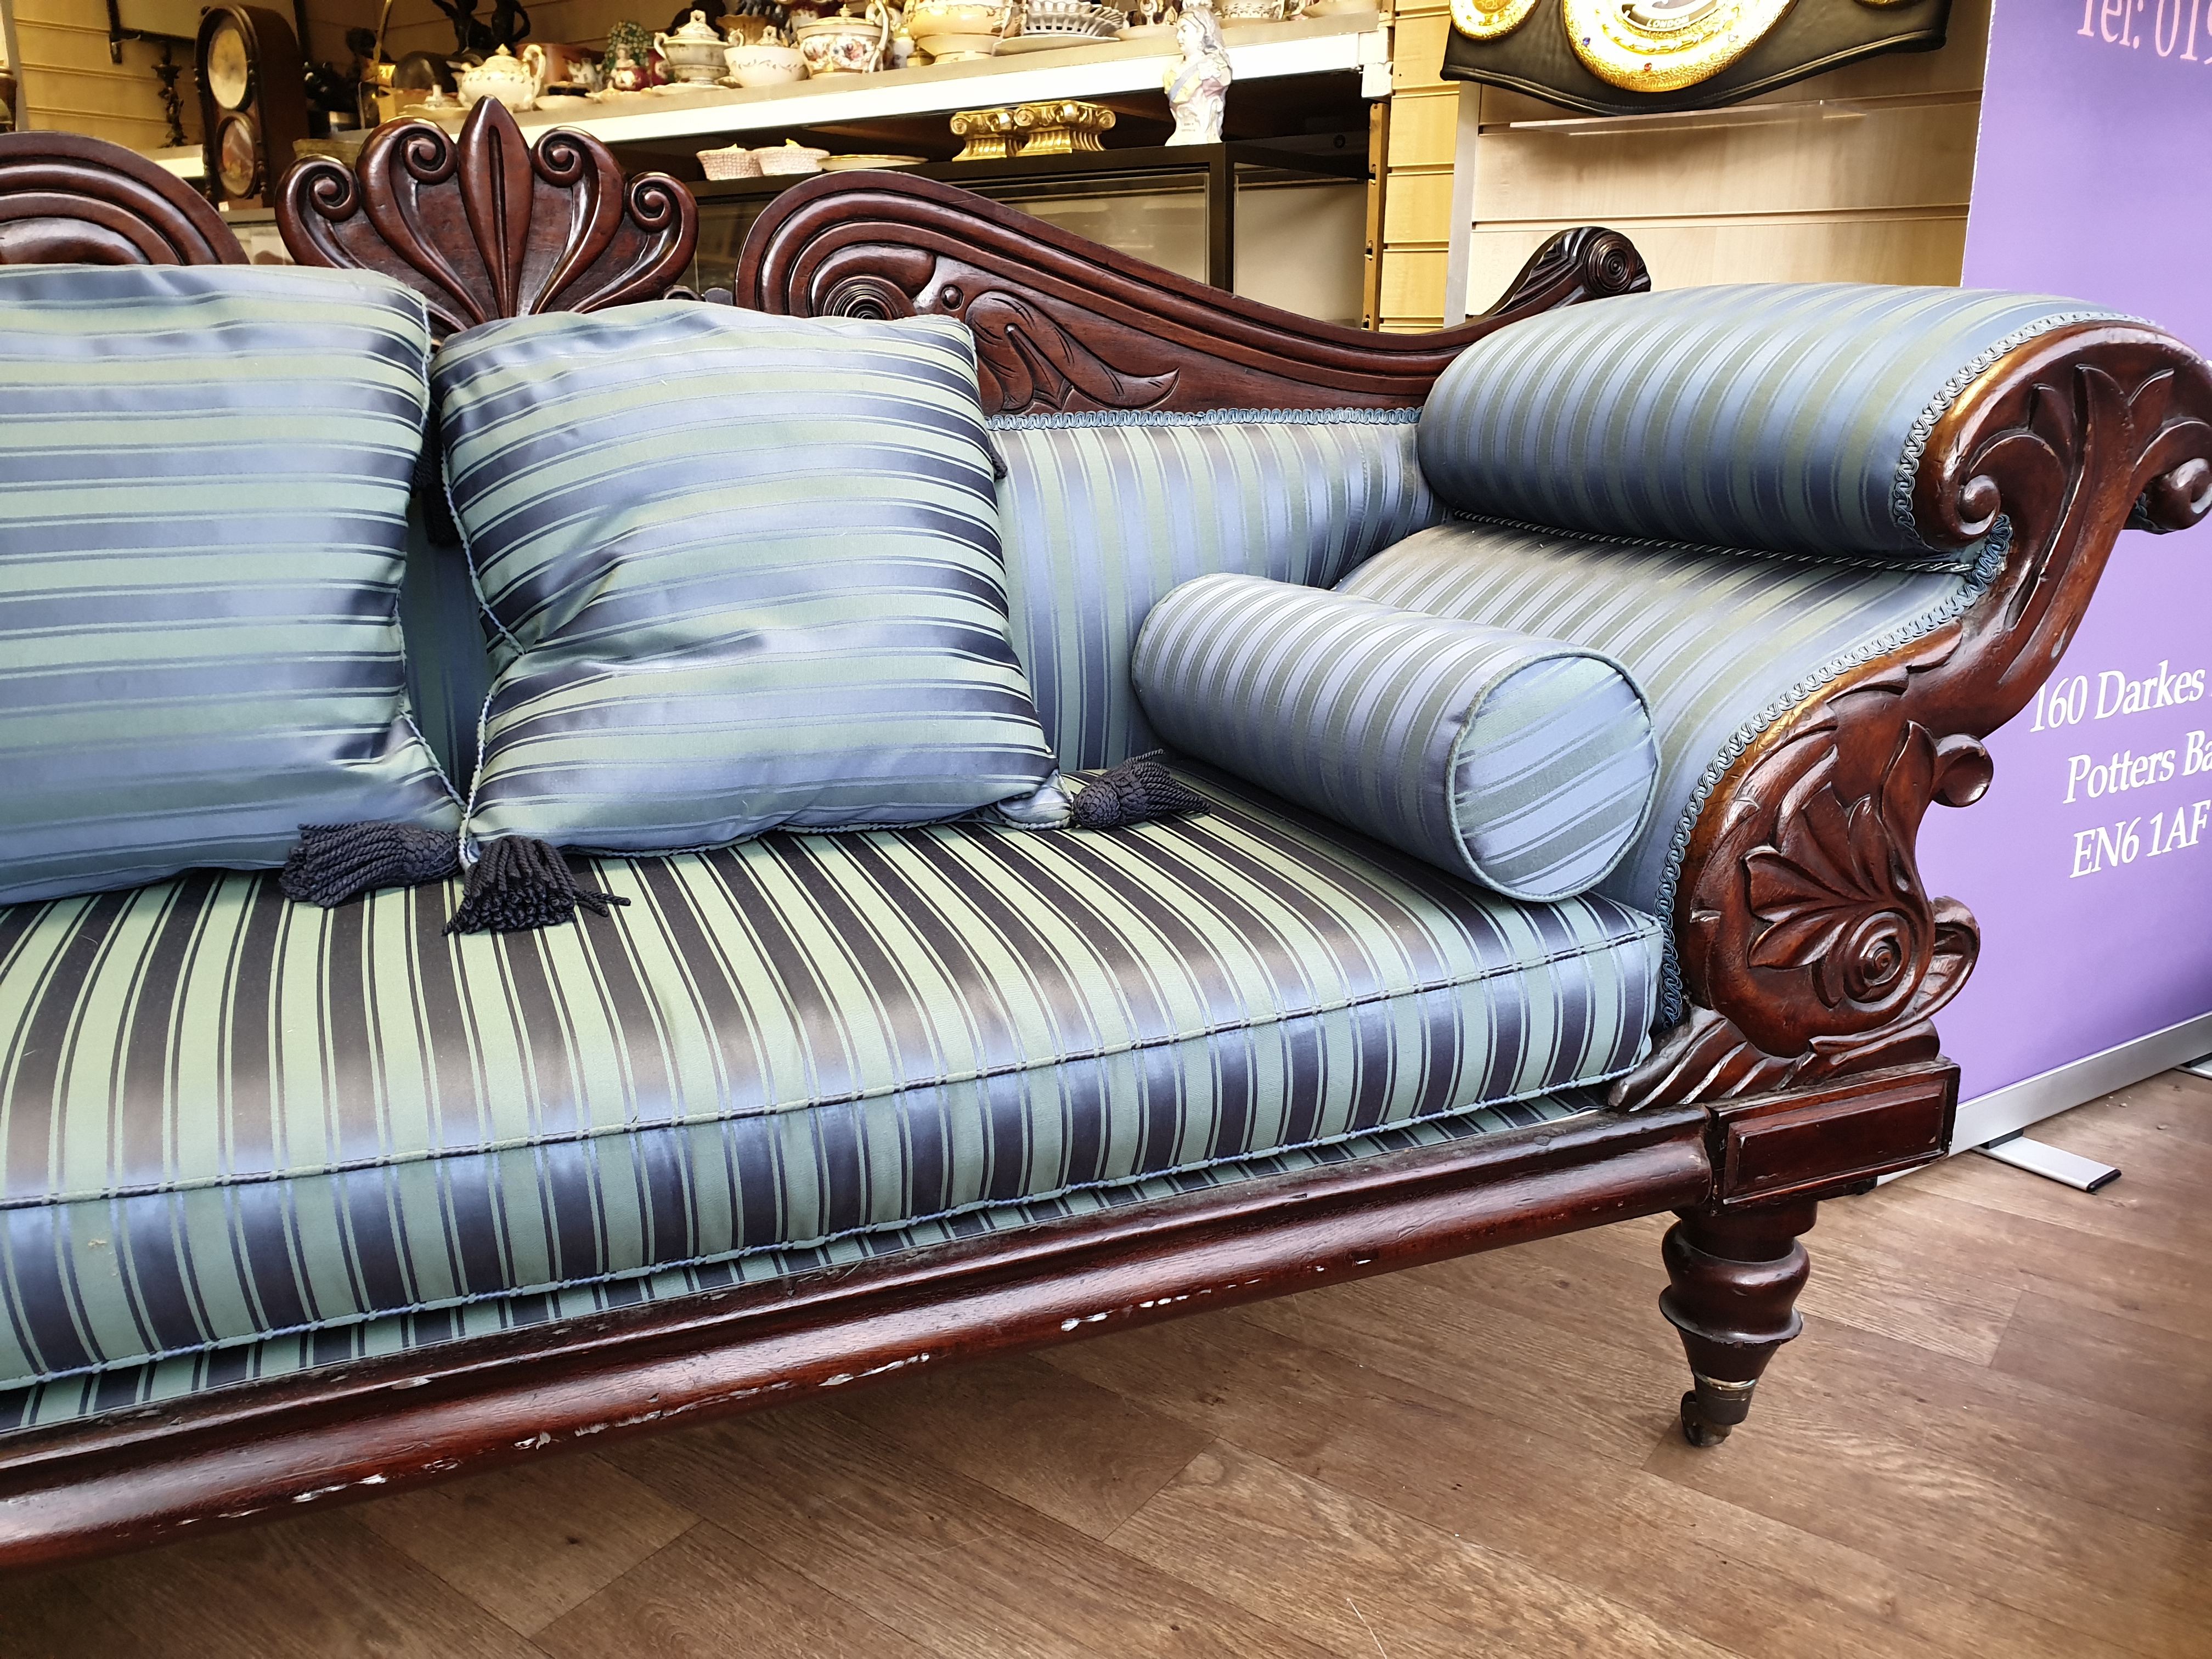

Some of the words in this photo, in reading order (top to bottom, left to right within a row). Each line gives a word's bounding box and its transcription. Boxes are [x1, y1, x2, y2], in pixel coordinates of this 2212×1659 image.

[1646, 15, 1690, 28] LONDON
[2030, 675, 2088, 732] 160
[2094, 659, 2206, 719] Darkes
[2063, 750, 2176, 804] Potters
[2069, 817, 2141, 878] EN6
[2147, 800, 2211, 857] 1AF
